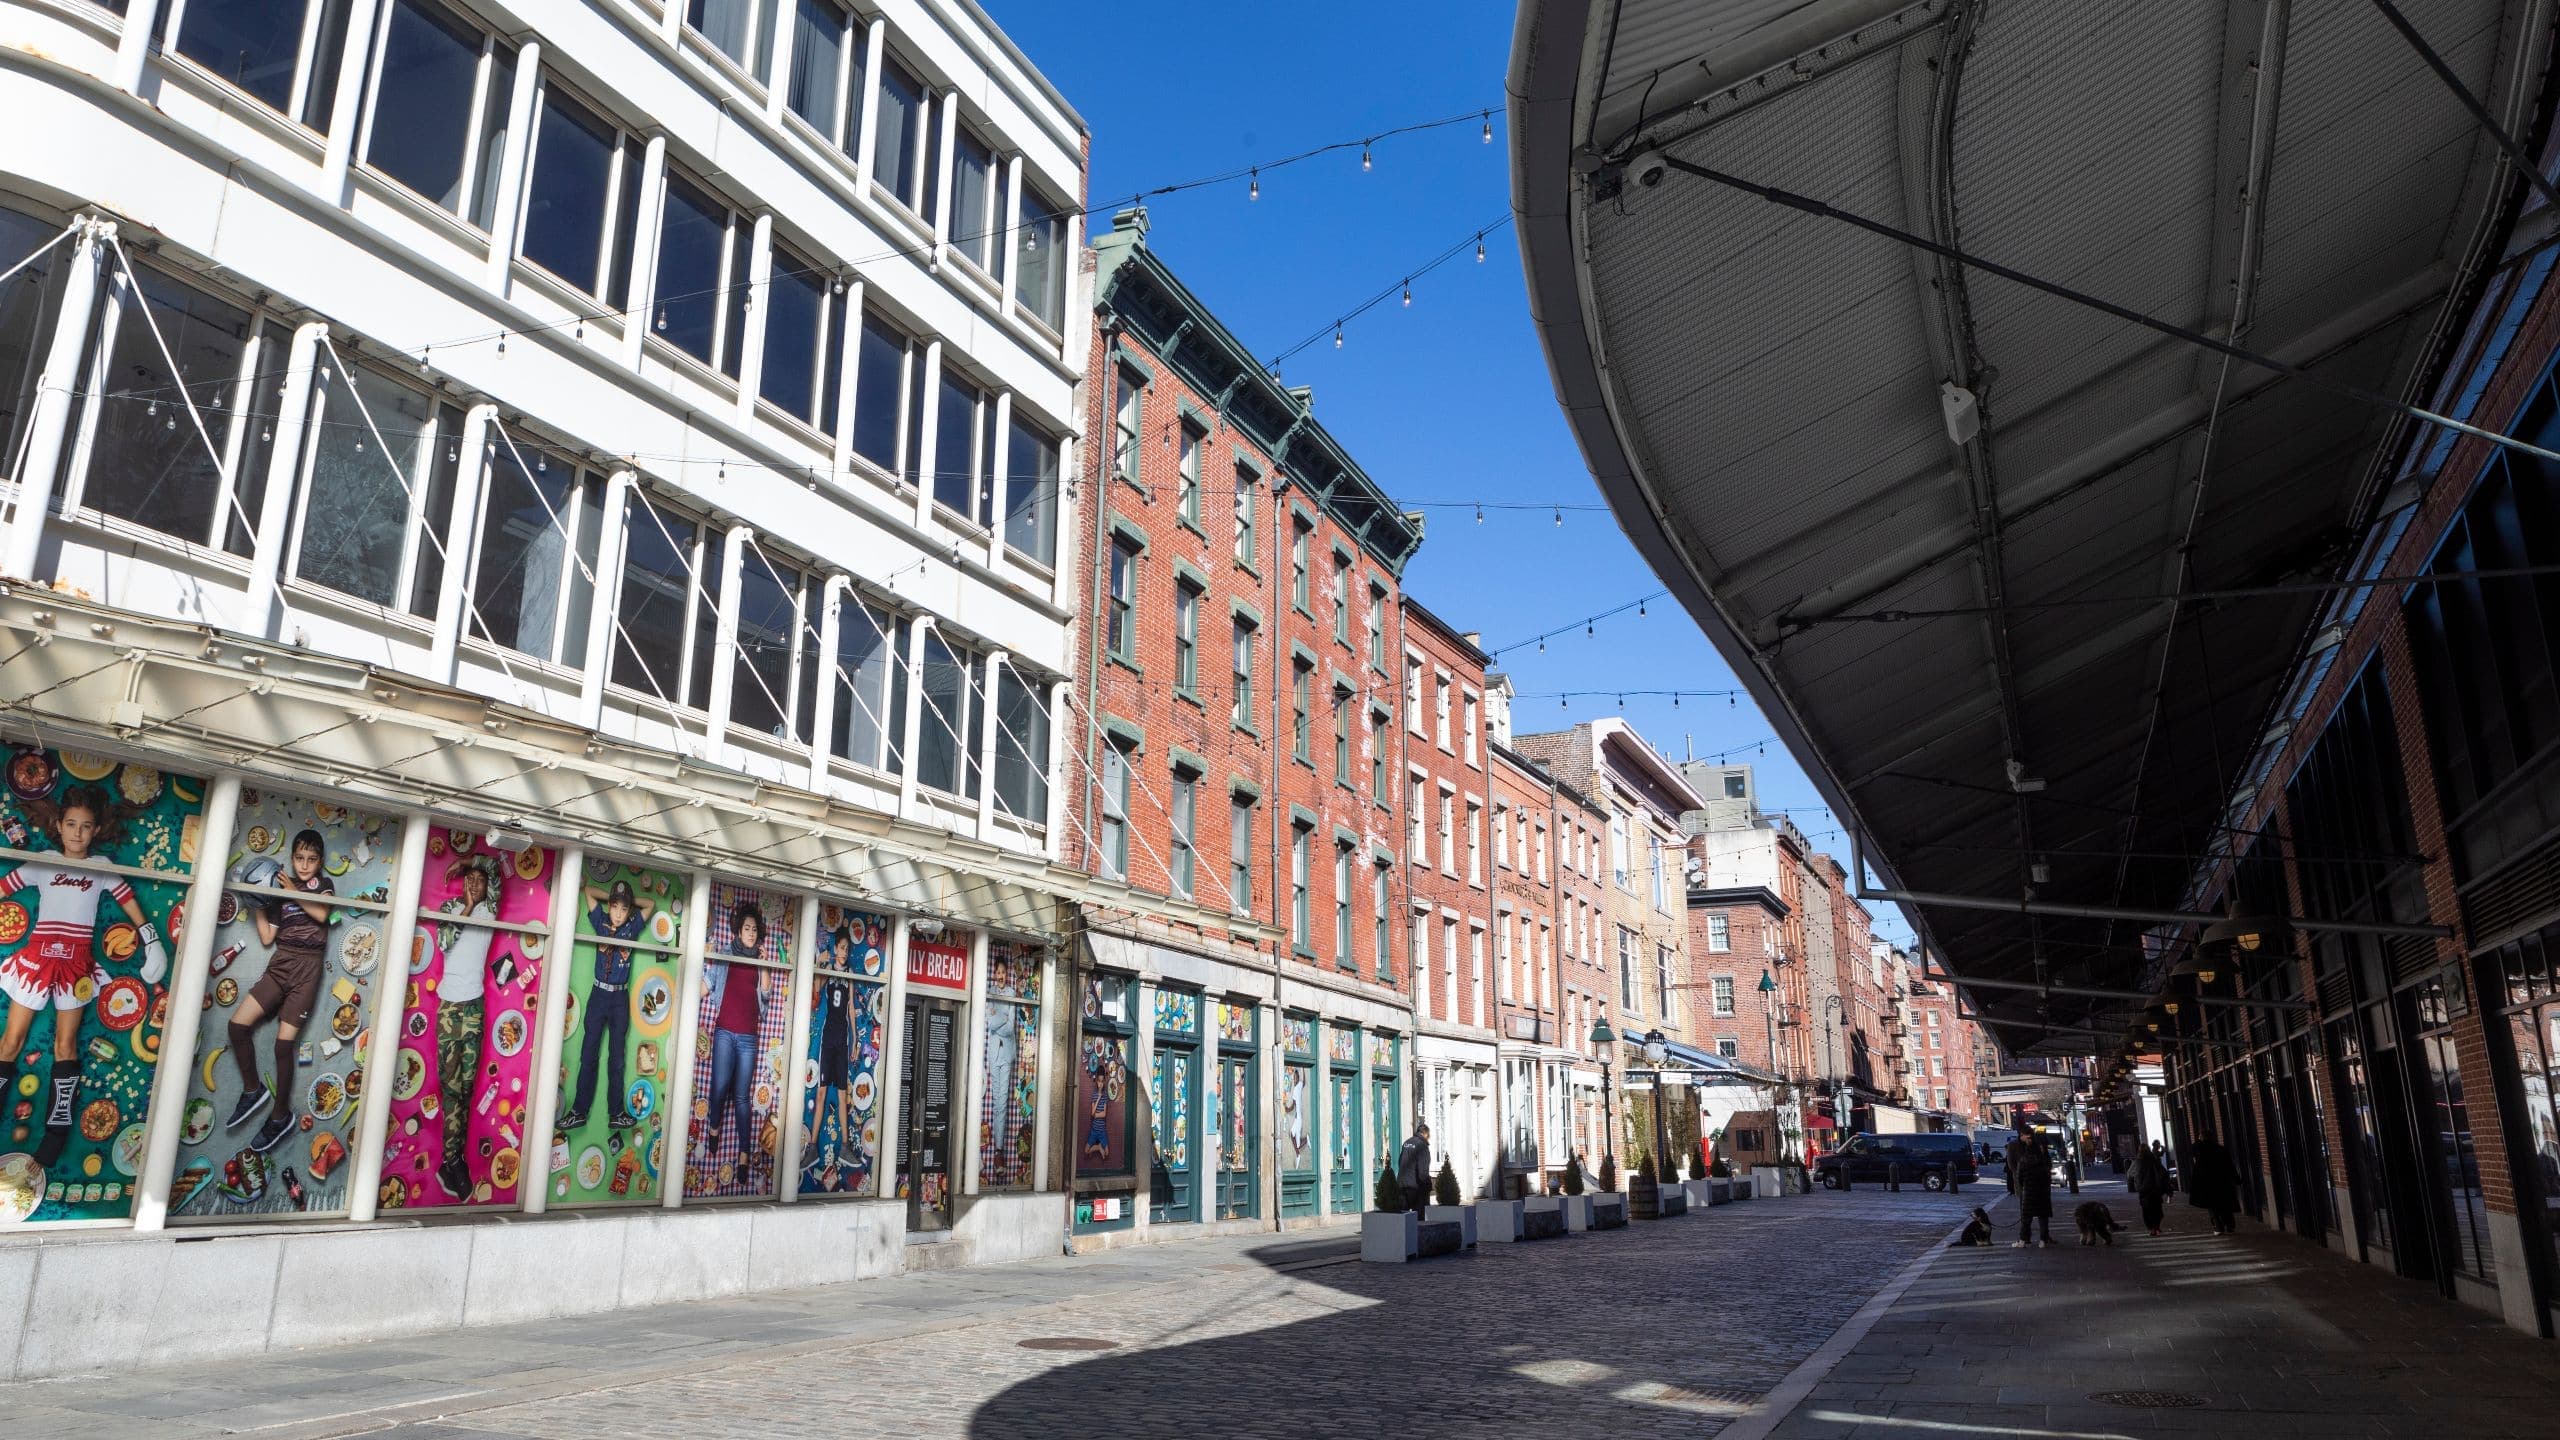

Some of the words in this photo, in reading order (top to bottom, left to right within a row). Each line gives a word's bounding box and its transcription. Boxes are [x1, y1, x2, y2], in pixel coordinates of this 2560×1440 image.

[50, 873, 93, 892] Lucky
[908, 948, 925, 975] ILY
[927, 952, 963, 981] BREAD
[833, 989, 841, 1007] 9
[51, 1081, 75, 1121] METAL
